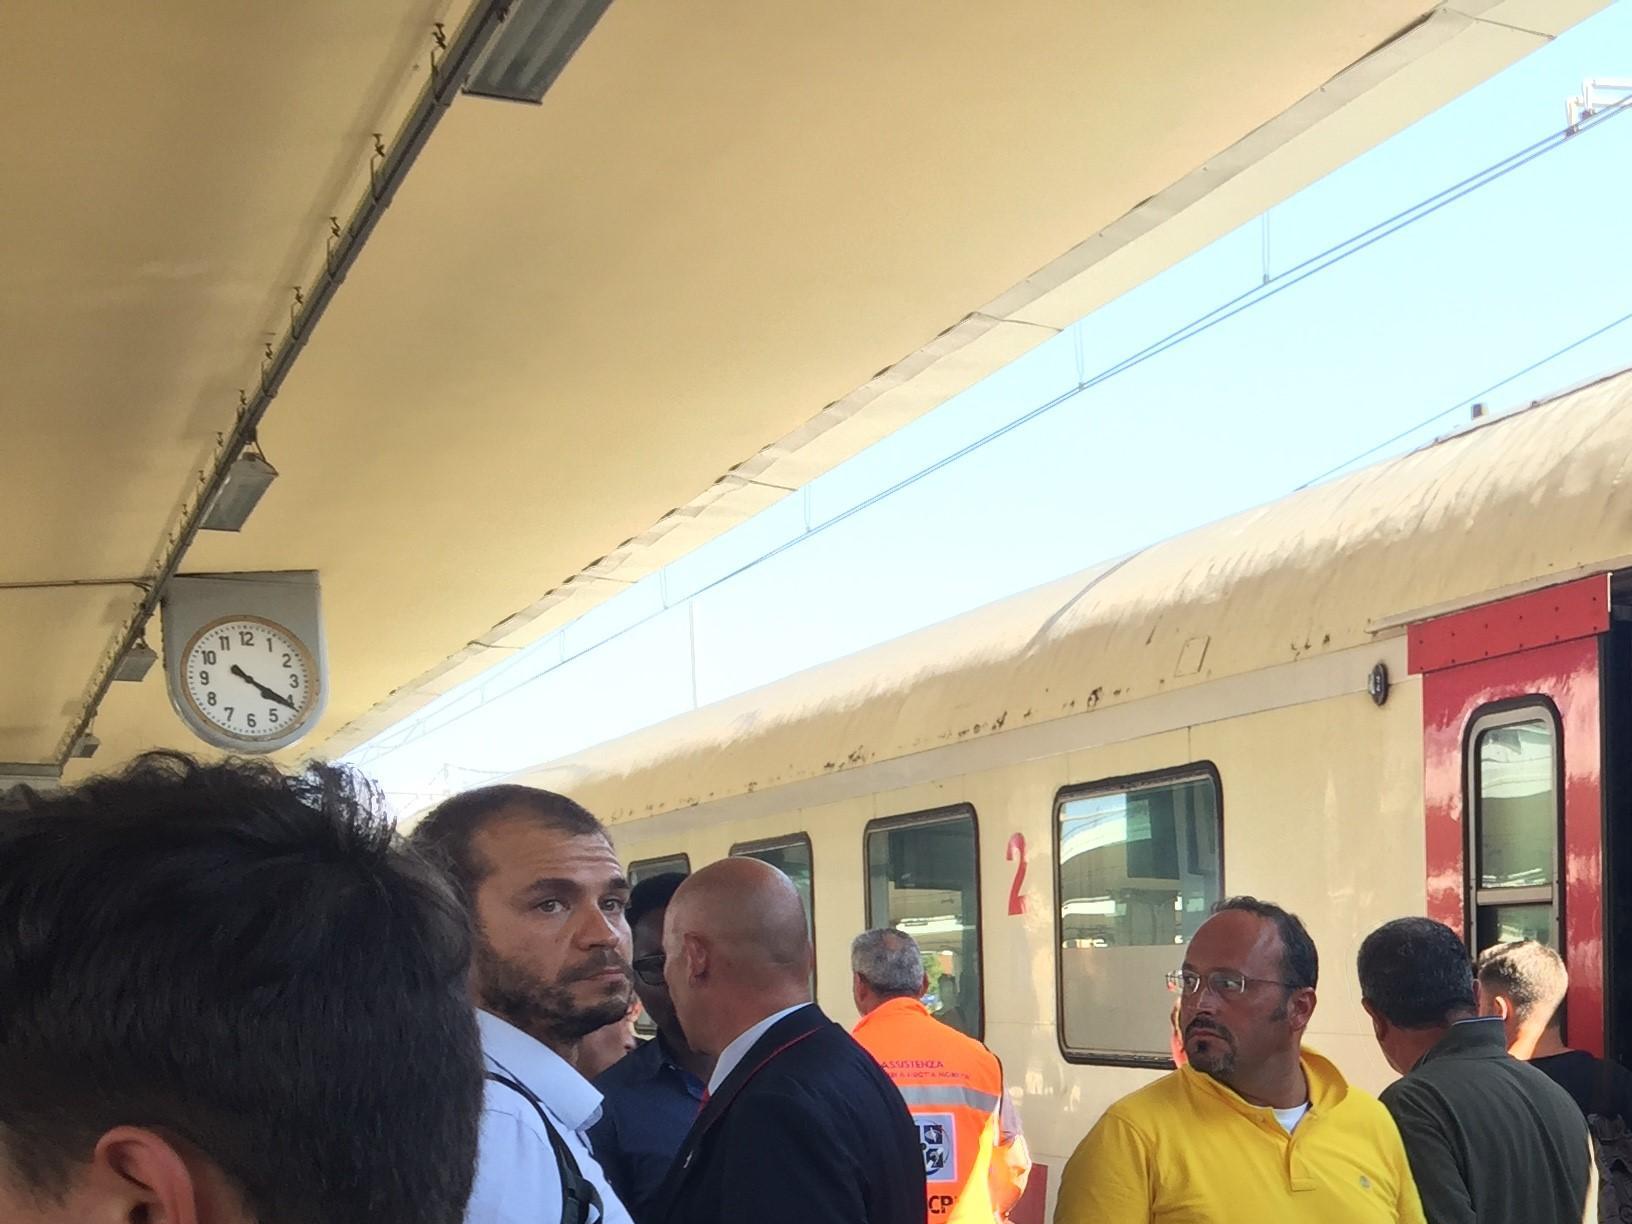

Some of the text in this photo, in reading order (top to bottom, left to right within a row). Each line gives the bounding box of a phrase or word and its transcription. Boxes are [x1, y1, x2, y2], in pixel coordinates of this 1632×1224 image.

[219, 635, 231, 651] 11
[239, 631, 255, 646] 12
[266, 638, 273, 652] 1
[201, 650, 217, 665] 10
[282, 653, 292, 668] 2
[200, 671, 210, 686] 9
[289, 674, 300, 689] 3
[207, 692, 217, 706] 8
[224, 707, 235, 722] 7
[247, 713, 257, 728] 6
[269, 708, 279, 723] 5
[1006, 831, 1027, 916] 2
